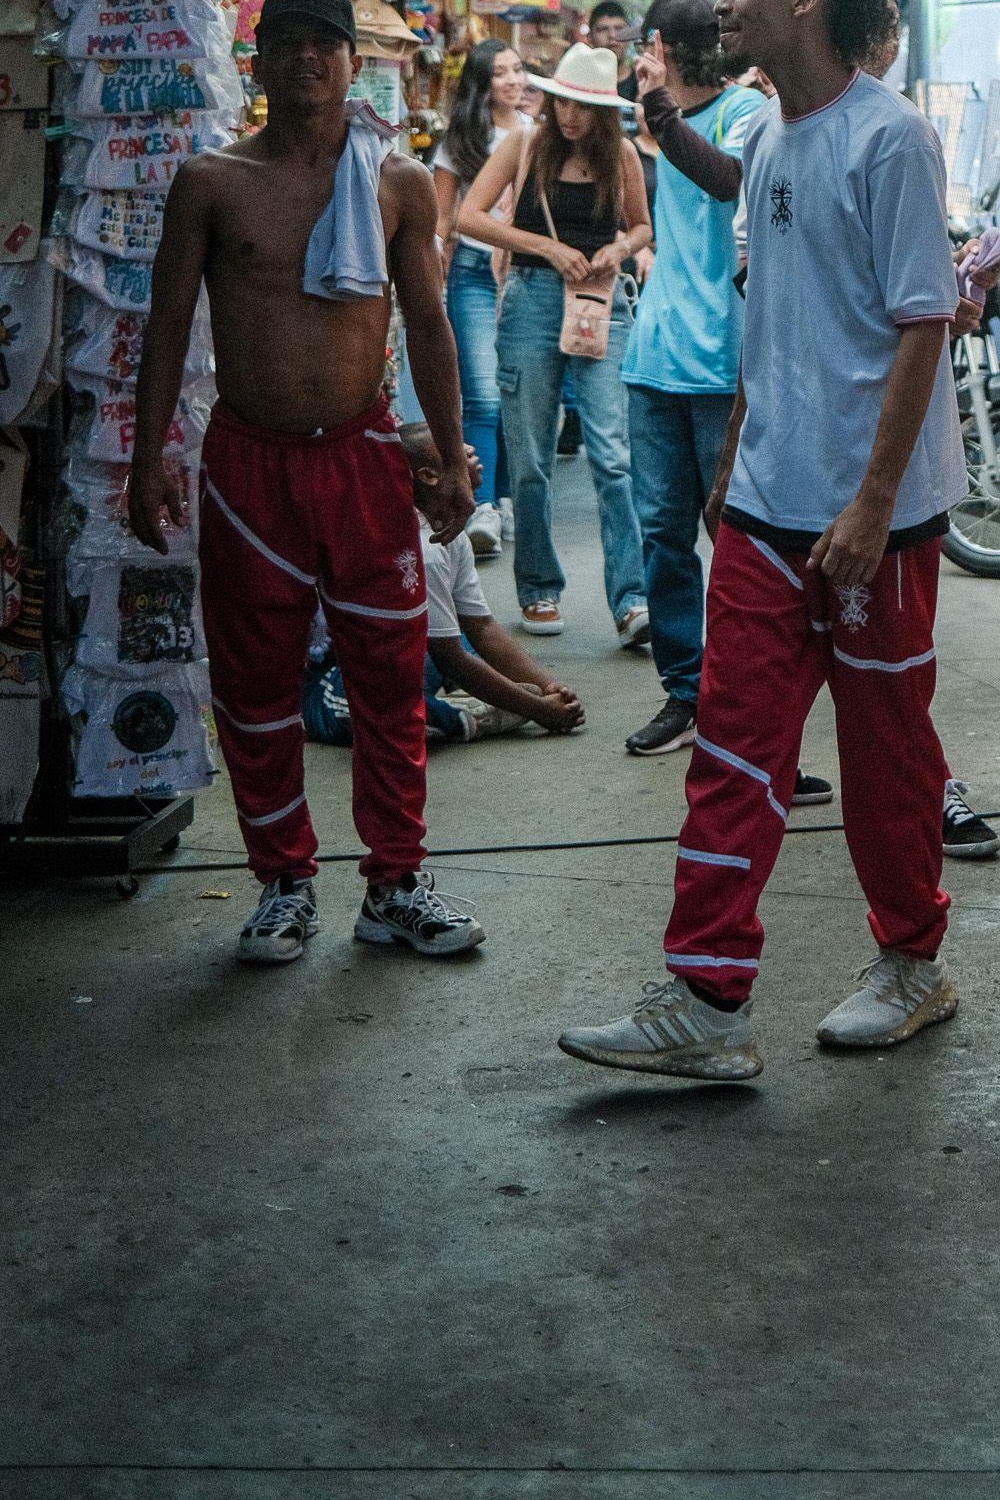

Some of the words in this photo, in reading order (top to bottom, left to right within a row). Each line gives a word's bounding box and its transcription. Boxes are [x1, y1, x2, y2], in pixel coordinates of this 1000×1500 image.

[99, 8, 158, 27] PRINCESA
[108, 132, 182, 161] PRINCESA
[134, 161, 159, 185] LA
